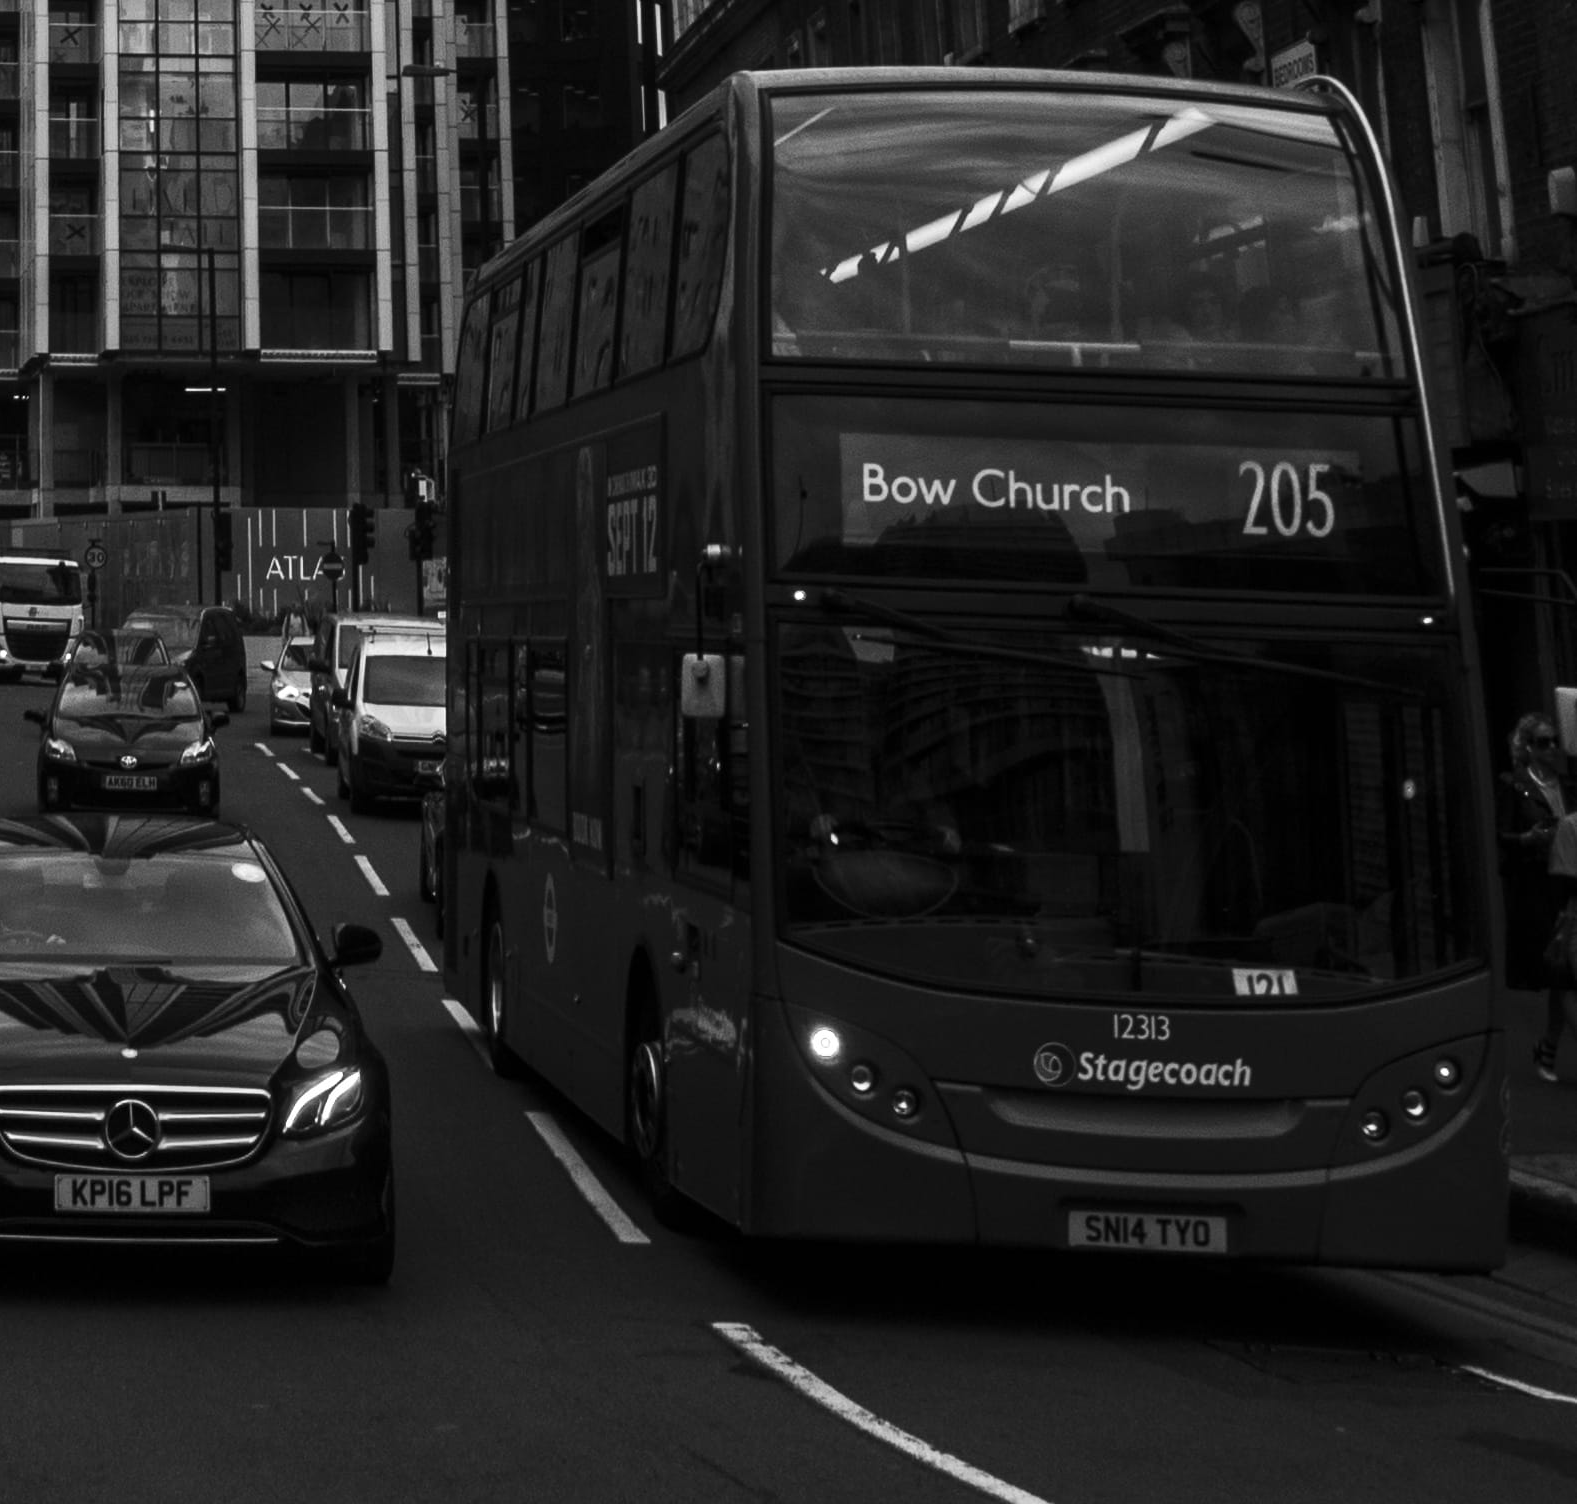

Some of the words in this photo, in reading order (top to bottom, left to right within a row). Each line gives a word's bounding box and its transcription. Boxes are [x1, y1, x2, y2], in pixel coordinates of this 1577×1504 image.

[1274, 52, 1314, 88] BEDROOMS
[861, 462, 956, 506] Bow
[971, 466, 1131, 514] Church
[1238, 458, 1336, 539] 205
[607, 498, 639, 577] SEPT
[642, 494, 658, 574] 12
[87, 551, 104, 562] 30
[1113, 1013, 1171, 1041] 12313
[1077, 1050, 1253, 1092] Stagecoach
[70, 1179, 133, 1207] KP16
[140, 1179, 193, 1207] LPF
[1084, 1215, 1147, 1244] SN14
[1155, 1217, 1211, 1247] TYO
